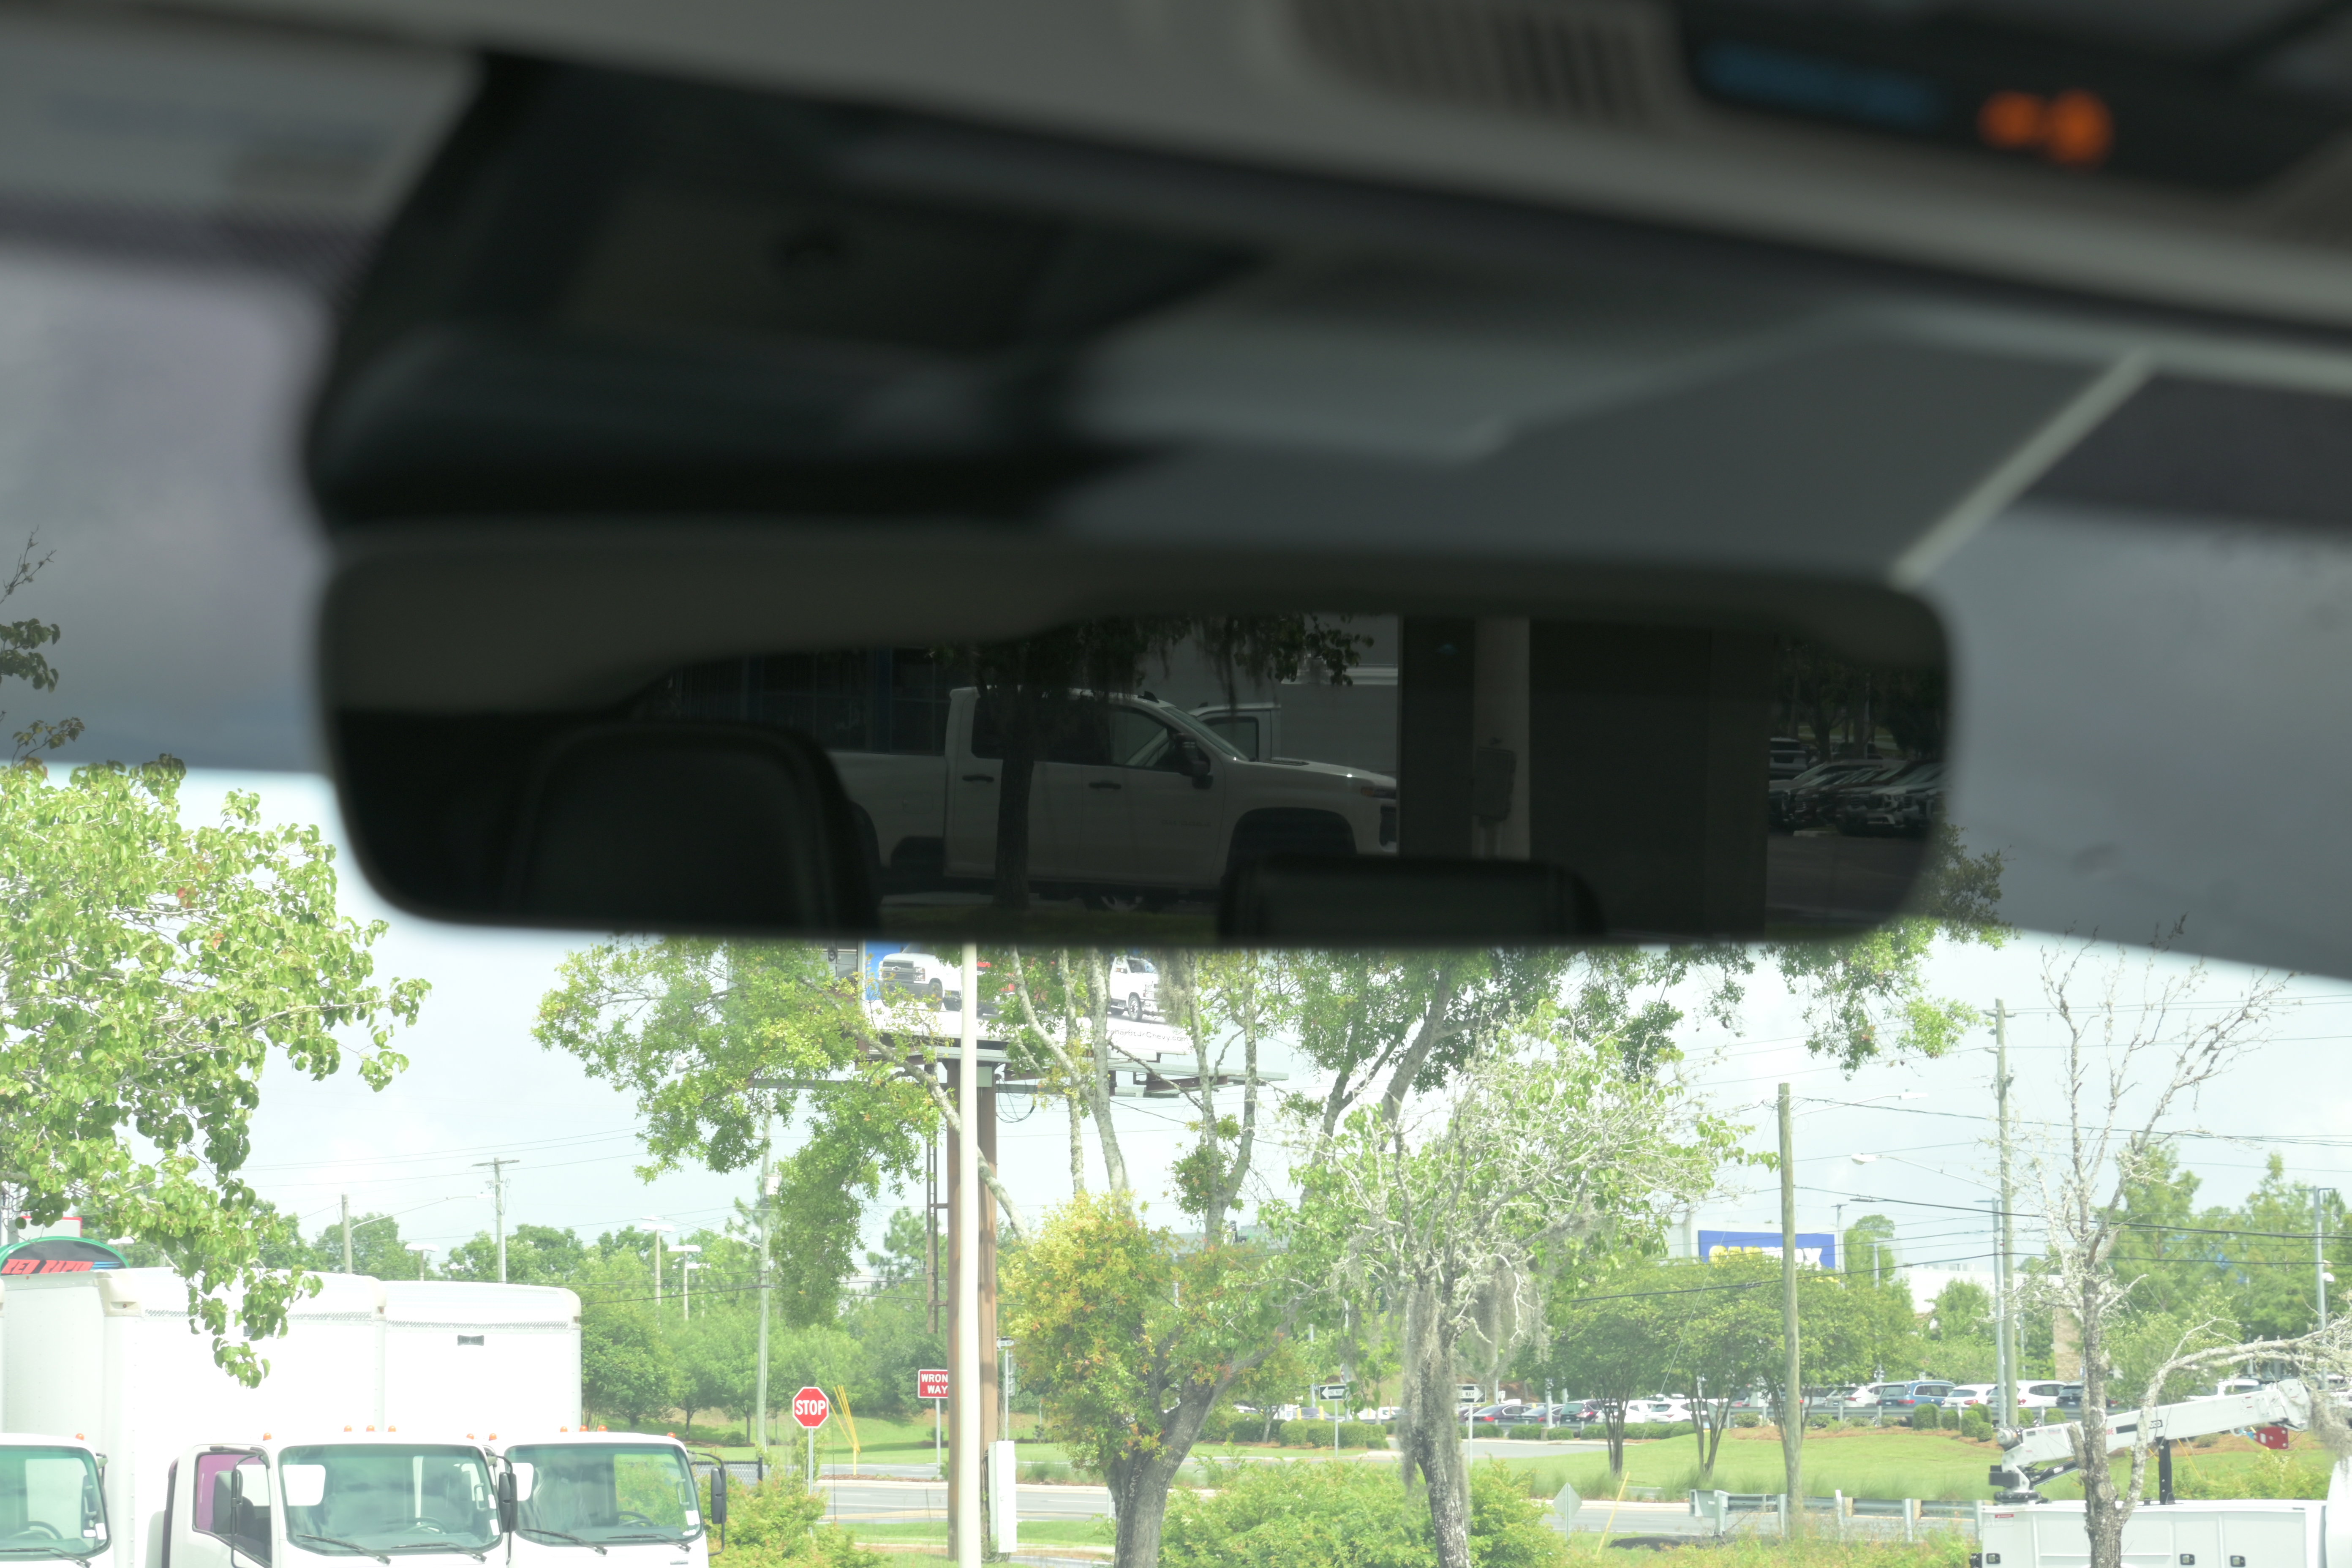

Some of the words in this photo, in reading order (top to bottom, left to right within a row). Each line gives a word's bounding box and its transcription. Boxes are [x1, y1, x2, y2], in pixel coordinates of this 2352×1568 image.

[1, 1259, 41, 1274] RED
[921, 1373, 948, 1383] WRON
[927, 1385, 948, 1394] WAY
[795, 1399, 826, 1416] STOP
